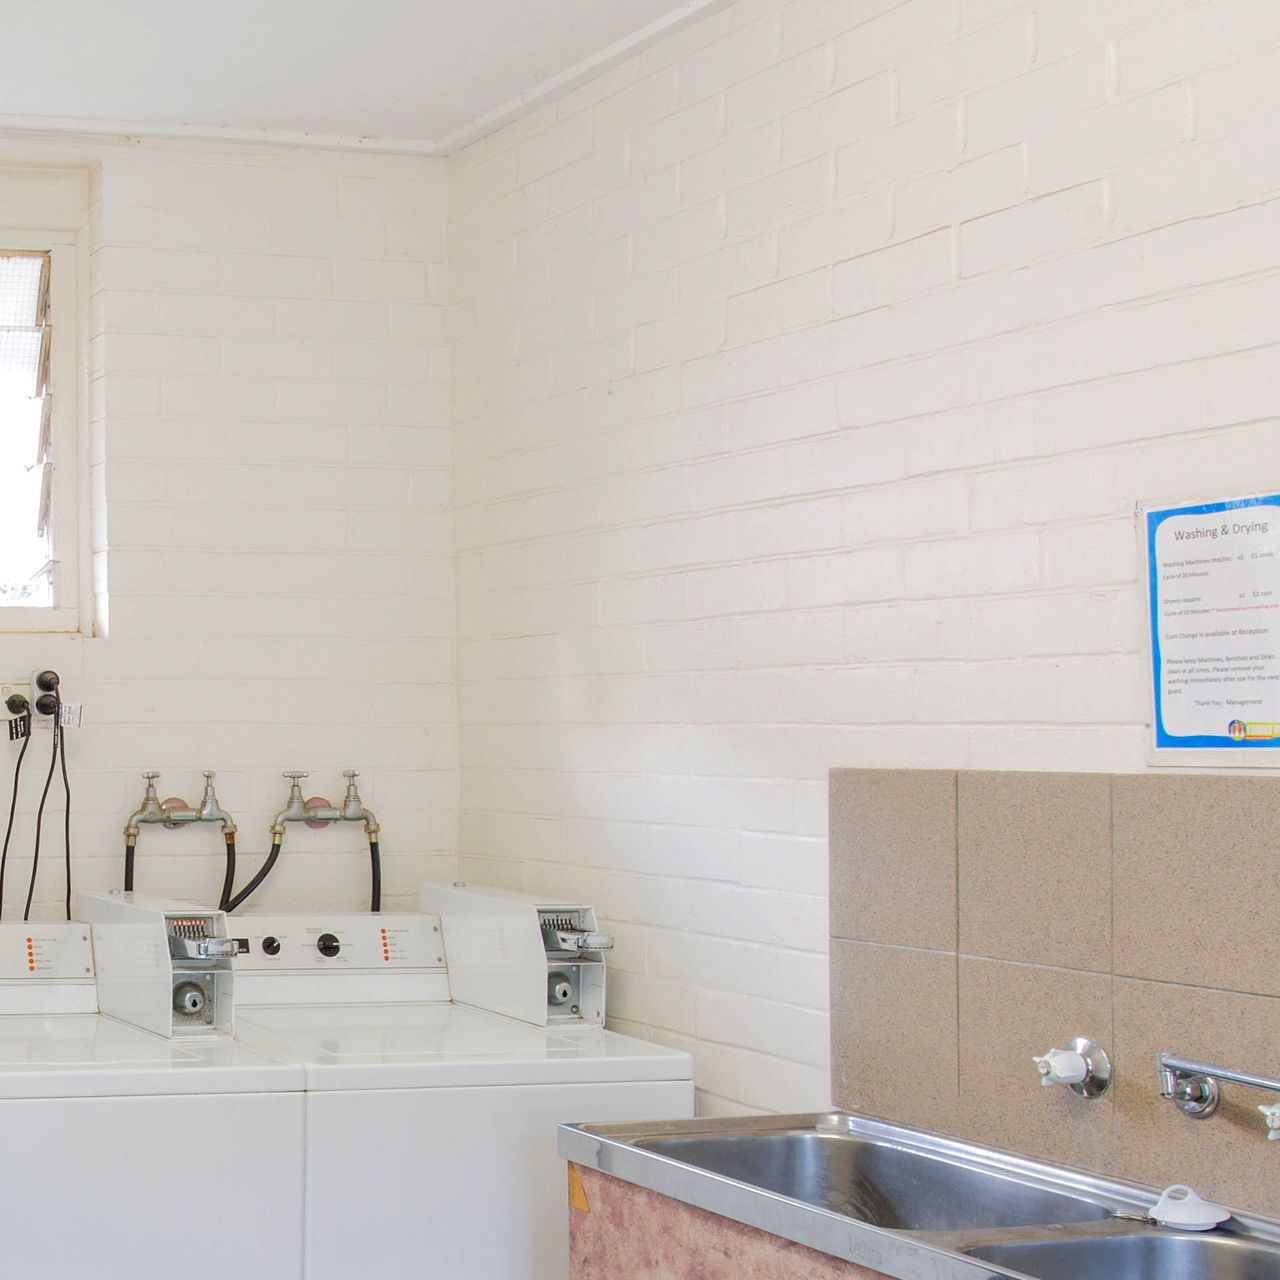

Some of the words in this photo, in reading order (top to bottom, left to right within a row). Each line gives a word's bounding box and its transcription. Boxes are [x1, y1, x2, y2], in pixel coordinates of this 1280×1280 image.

[1174, 525, 1218, 543] Washing
[1220, 524, 1228, 536] &
[1232, 519, 1268, 536] Drying
